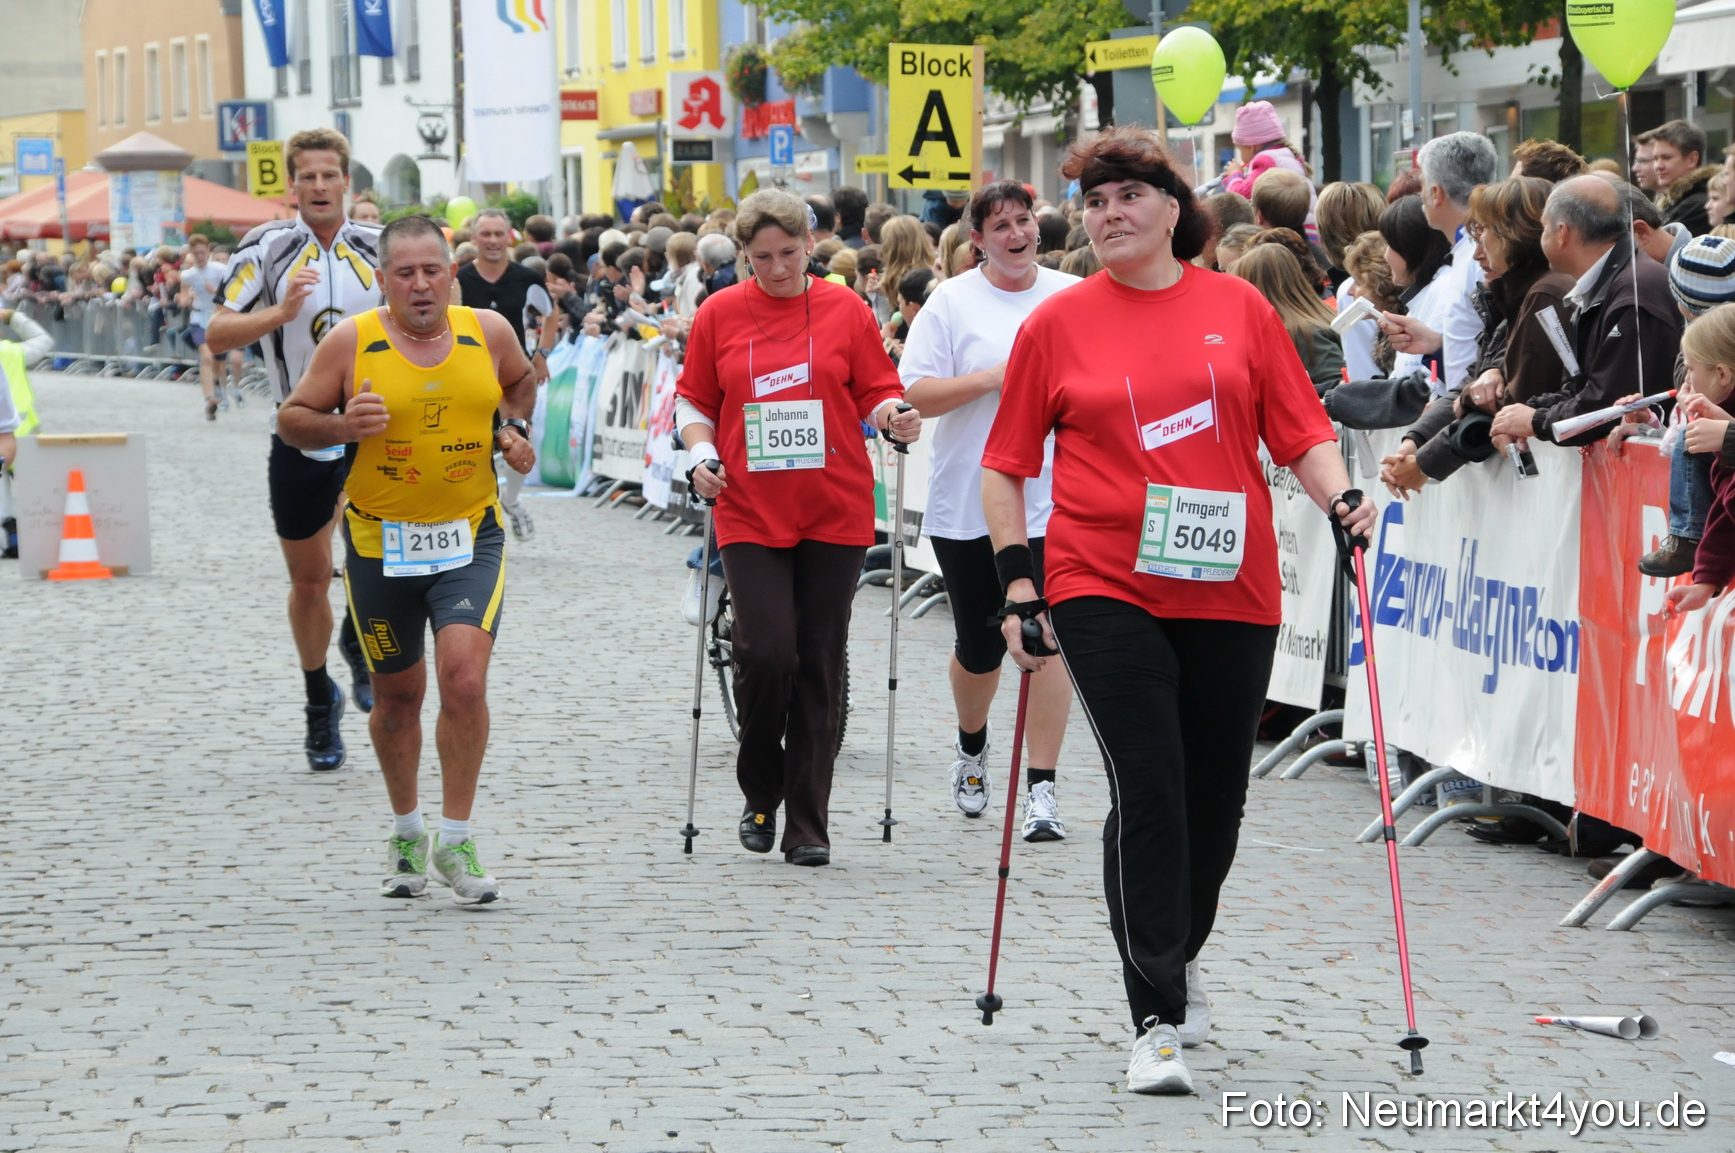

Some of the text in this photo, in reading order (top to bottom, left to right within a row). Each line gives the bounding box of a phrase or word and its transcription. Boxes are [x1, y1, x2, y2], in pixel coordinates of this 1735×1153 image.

[1102, 45, 1149, 61] Toiletten
[900, 51, 973, 77] Block
[908, 89, 962, 158] A
[251, 143, 281, 155] Block
[774, 130, 789, 161] P
[258, 159, 278, 185] B
[770, 373, 794, 388] DEHN
[765, 408, 809, 422] Johanna
[748, 430, 755, 440] S
[1162, 415, 1193, 437] DEHN
[768, 427, 818, 448] 5058
[385, 446, 412, 457] Seidl
[795, 457, 824, 465] PFLEIDERER
[449, 467, 474, 479] ELIO
[1176, 496, 1230, 519] Irmgard
[1148, 520, 1155, 533] S
[389, 532, 396, 543] A
[410, 529, 461, 551] 2181
[1173, 525, 1237, 553] 5049
[373, 623, 397, 656] Run!
